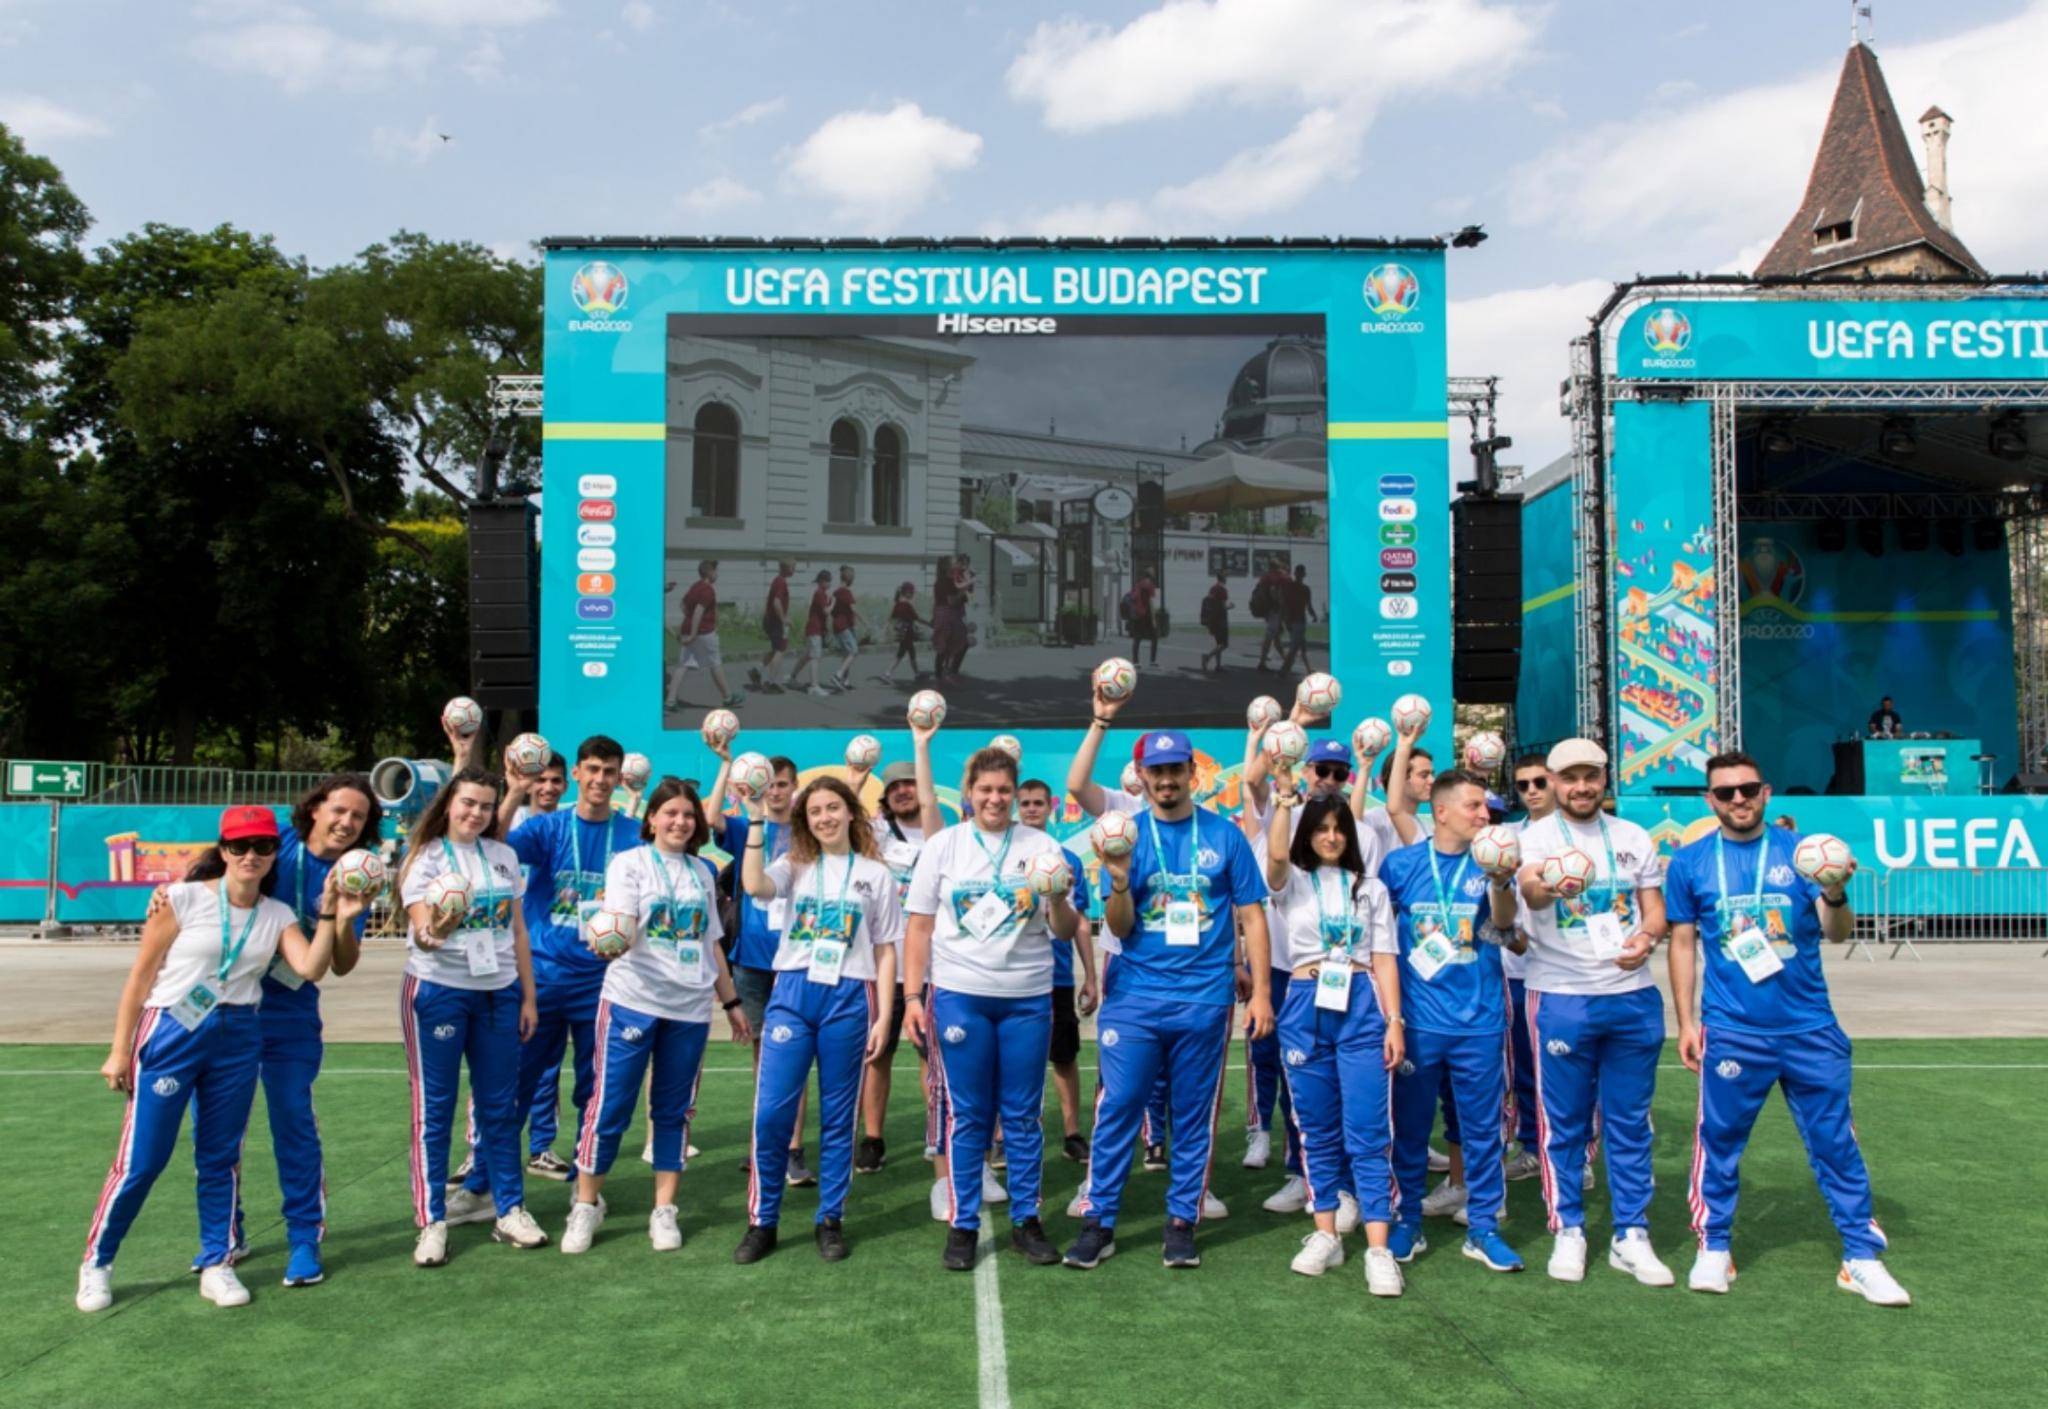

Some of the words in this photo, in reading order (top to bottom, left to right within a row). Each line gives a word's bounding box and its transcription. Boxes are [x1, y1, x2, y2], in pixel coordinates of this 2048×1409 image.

[727, 267, 830, 305] UEFA
[842, 267, 1042, 305] FESTIVAL
[1053, 267, 1267, 304] BUDAPEST
[937, 313, 1057, 334] Hisense
[1808, 319, 1914, 359] UEFA
[1873, 818, 2043, 869] UEFA
